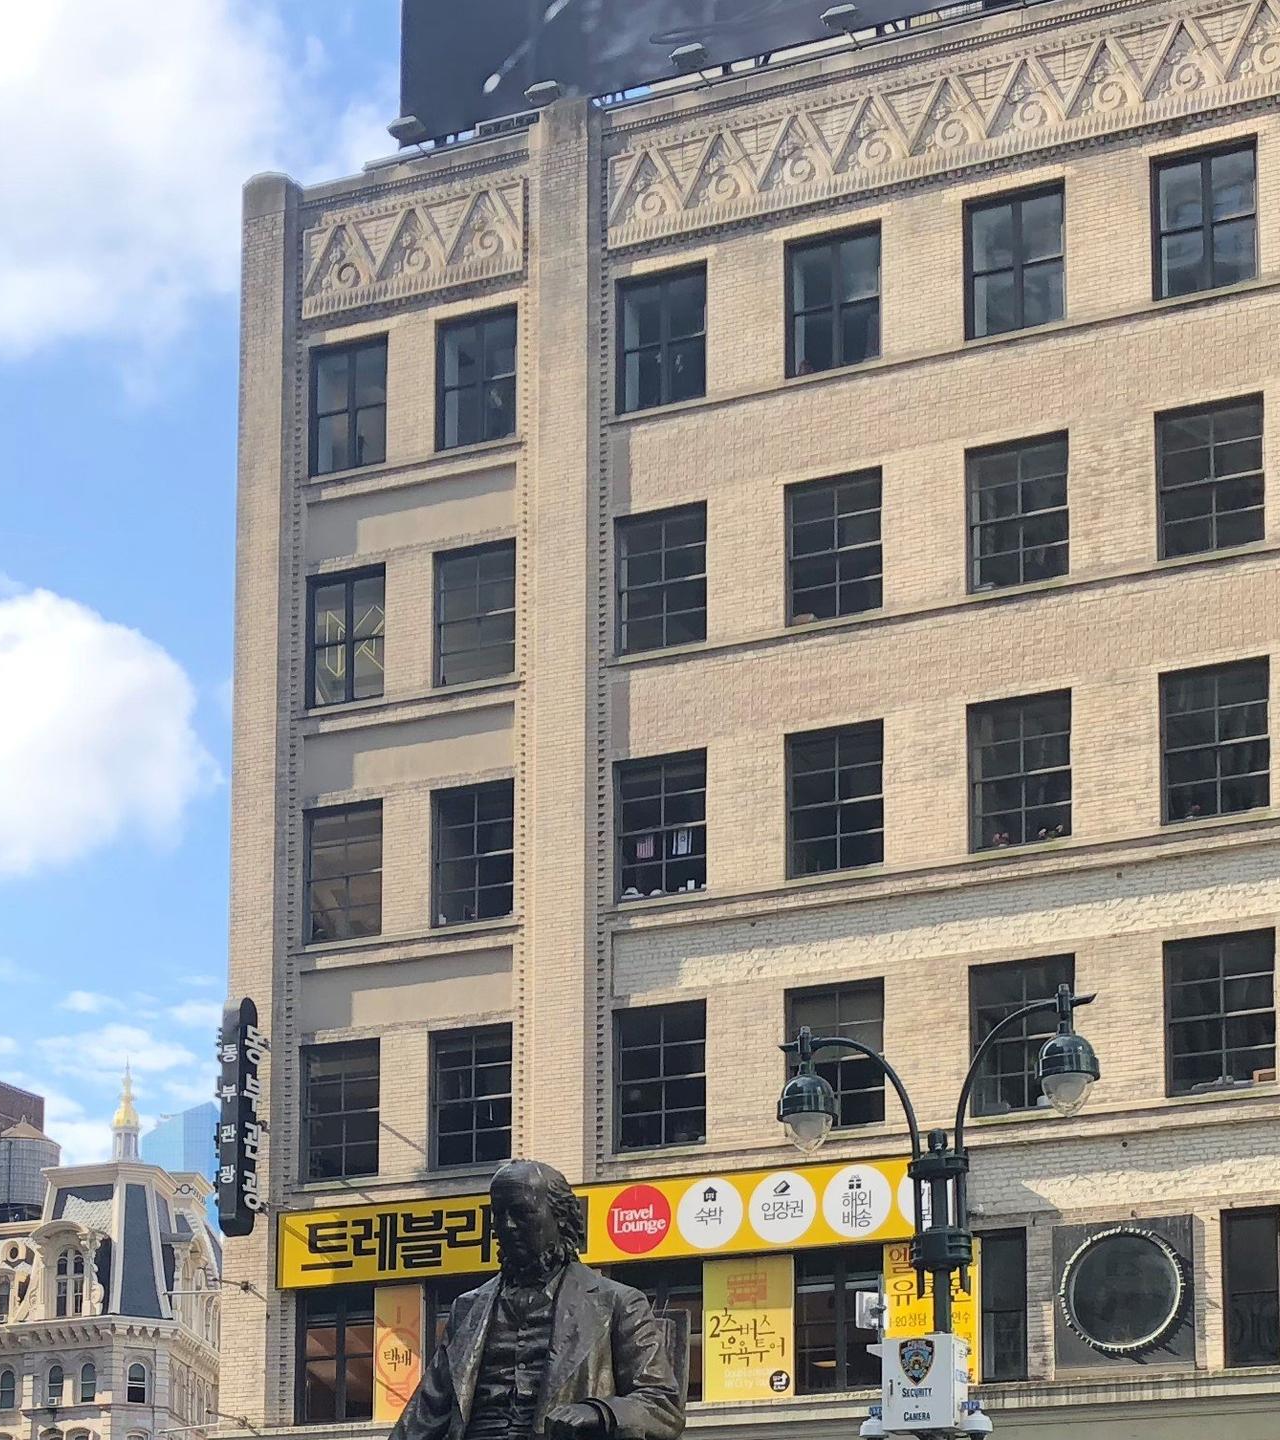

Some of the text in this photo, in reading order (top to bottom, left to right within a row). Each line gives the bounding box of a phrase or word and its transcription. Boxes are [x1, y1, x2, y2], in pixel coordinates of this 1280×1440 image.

[220, 1042, 238, 1184] 동부관광
[242, 1025, 266, 1211] 동부관광
[761, 1199, 804, 1220] 입장권
[842, 1190, 872, 1209] 해외
[611, 1203, 653, 1221] Travel
[694, 1204, 724, 1226] 숙박
[842, 1208, 872, 1228] 배송
[613, 1218, 666, 1234] Lounge
[709, 1307, 776, 1345] 2층버스
[383, 1347, 412, 1371] 택배
[719, 1337, 785, 1367] 뉴욕투어
[901, 1387, 933, 1399] SECURITY
[903, 1410, 931, 1422] CAMERA
